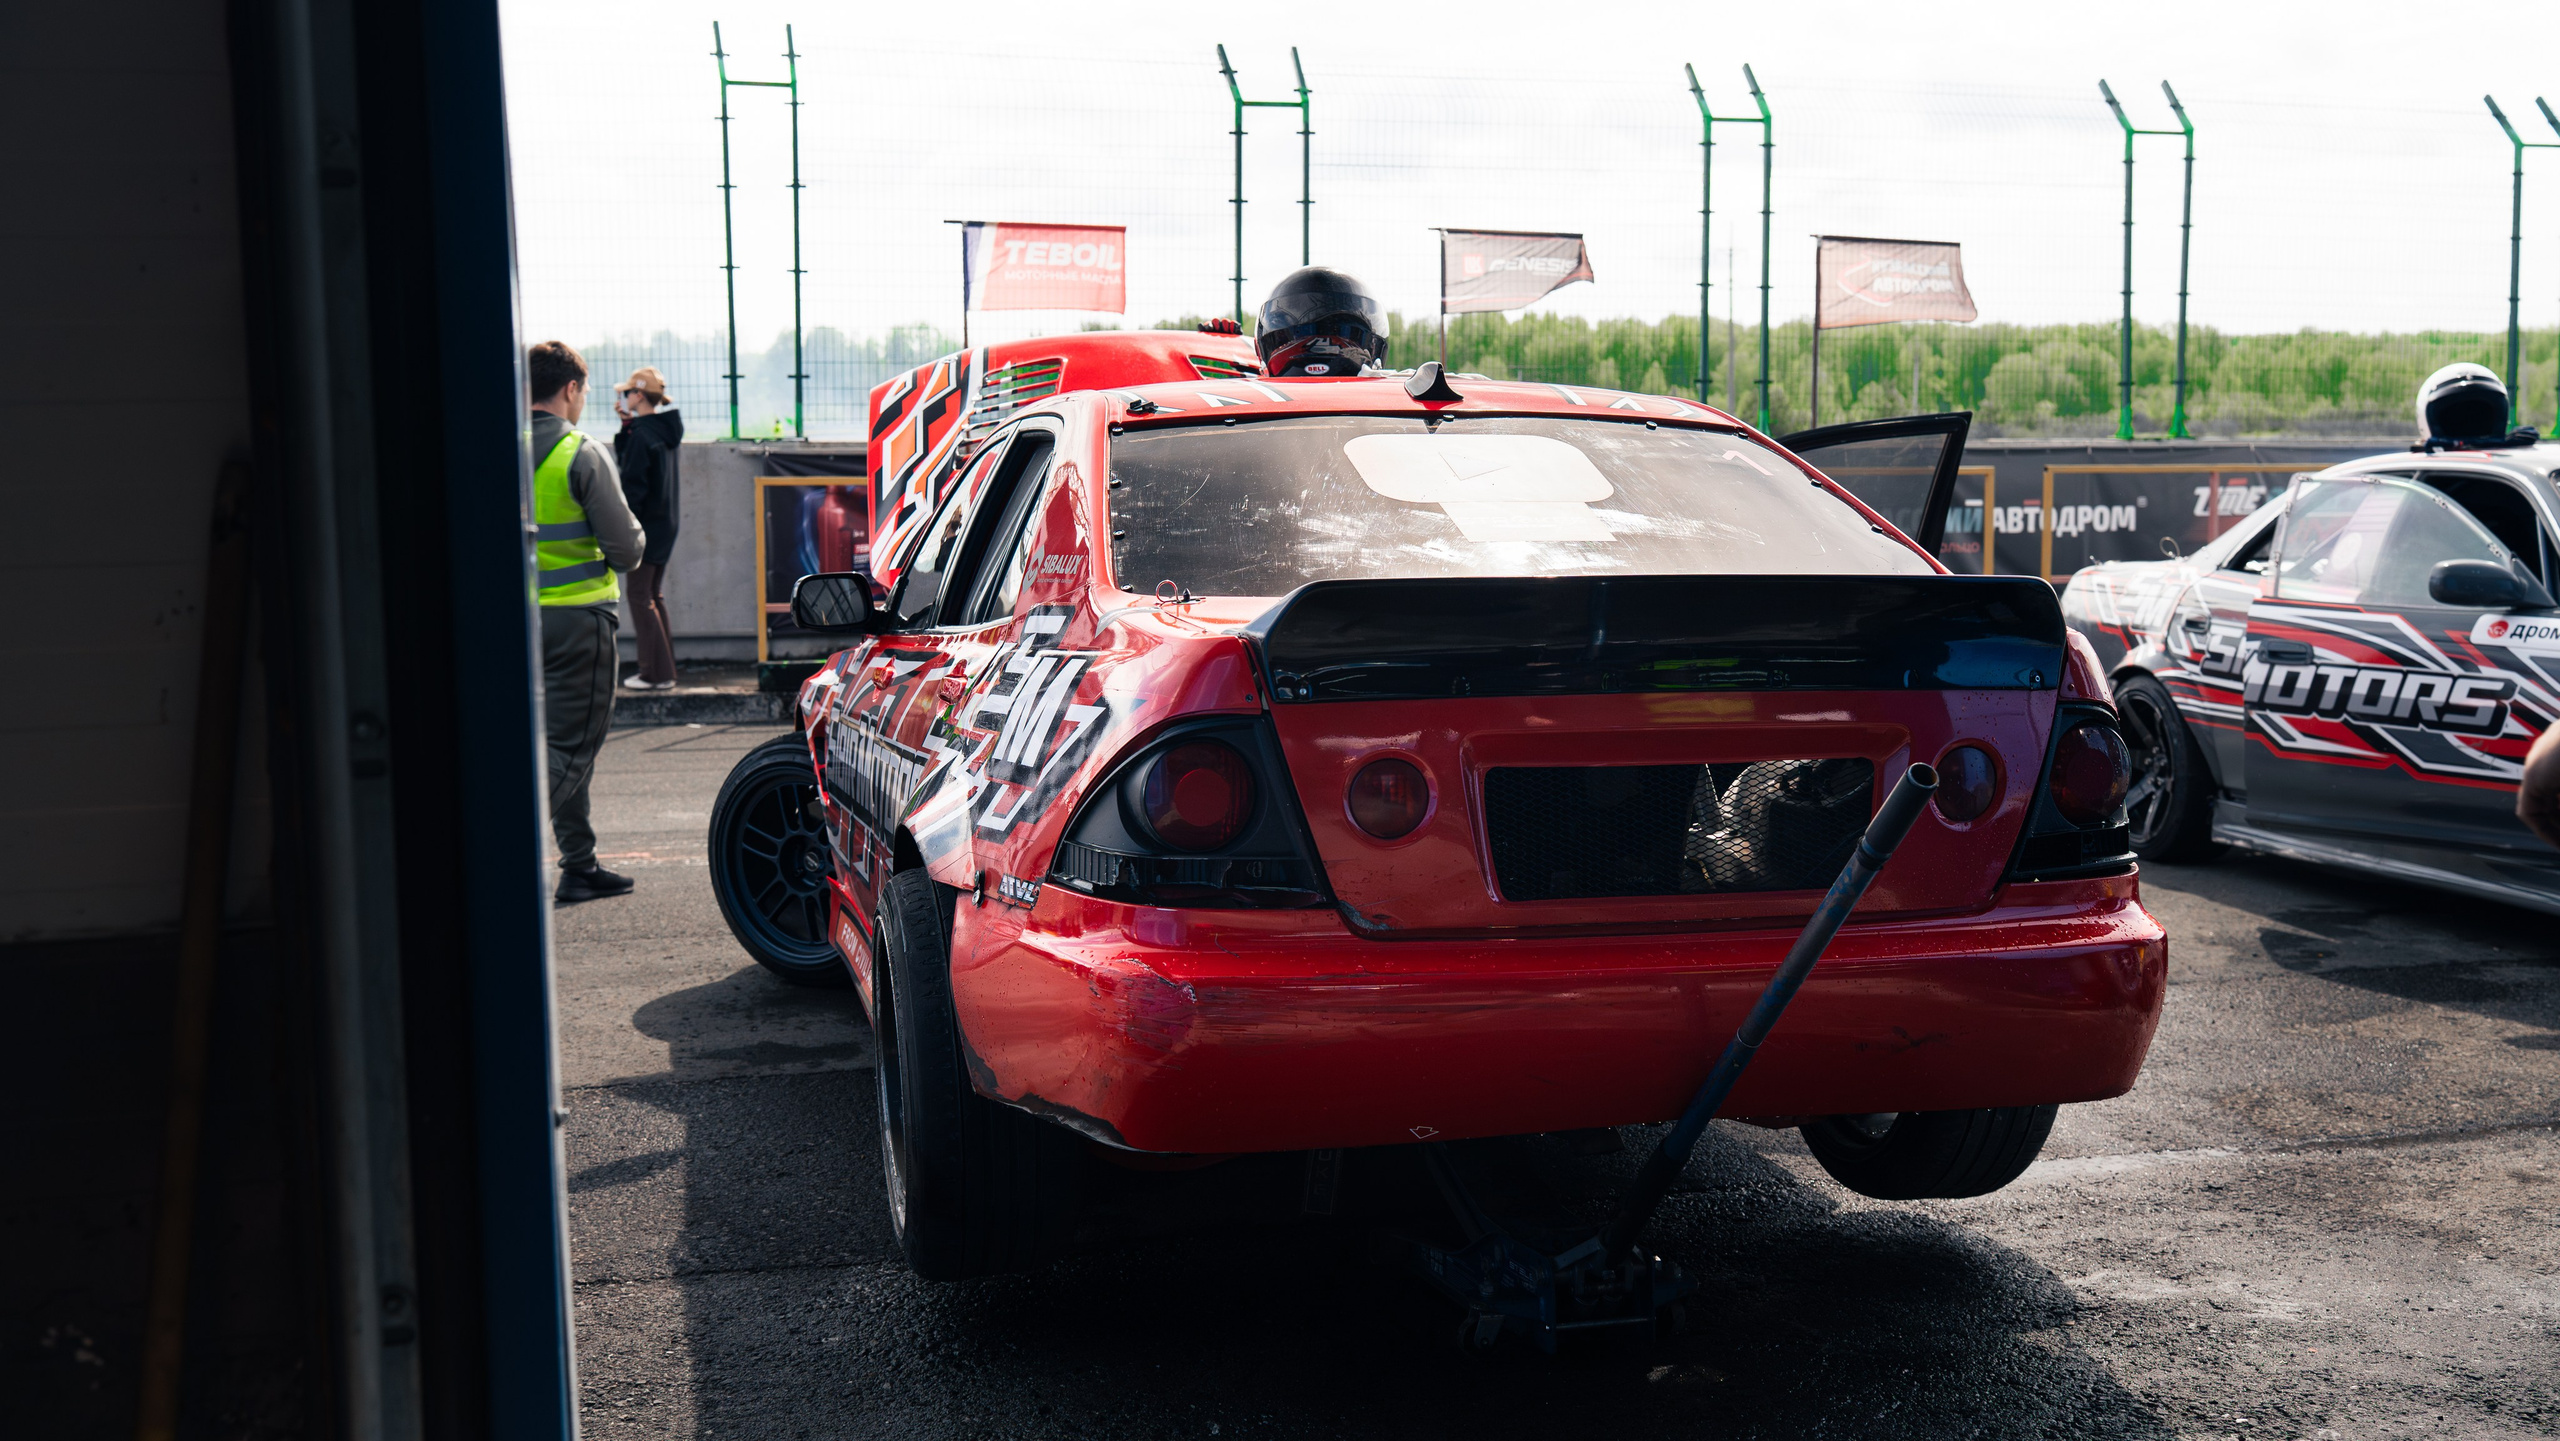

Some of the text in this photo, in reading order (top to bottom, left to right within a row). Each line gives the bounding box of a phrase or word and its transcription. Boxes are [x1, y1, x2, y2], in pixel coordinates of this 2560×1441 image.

[1004, 240, 1122, 271] TEBOIL
[1941, 542, 1981, 554] ОЛЬЦО
[1041, 554, 1084, 574] SIBALUX
